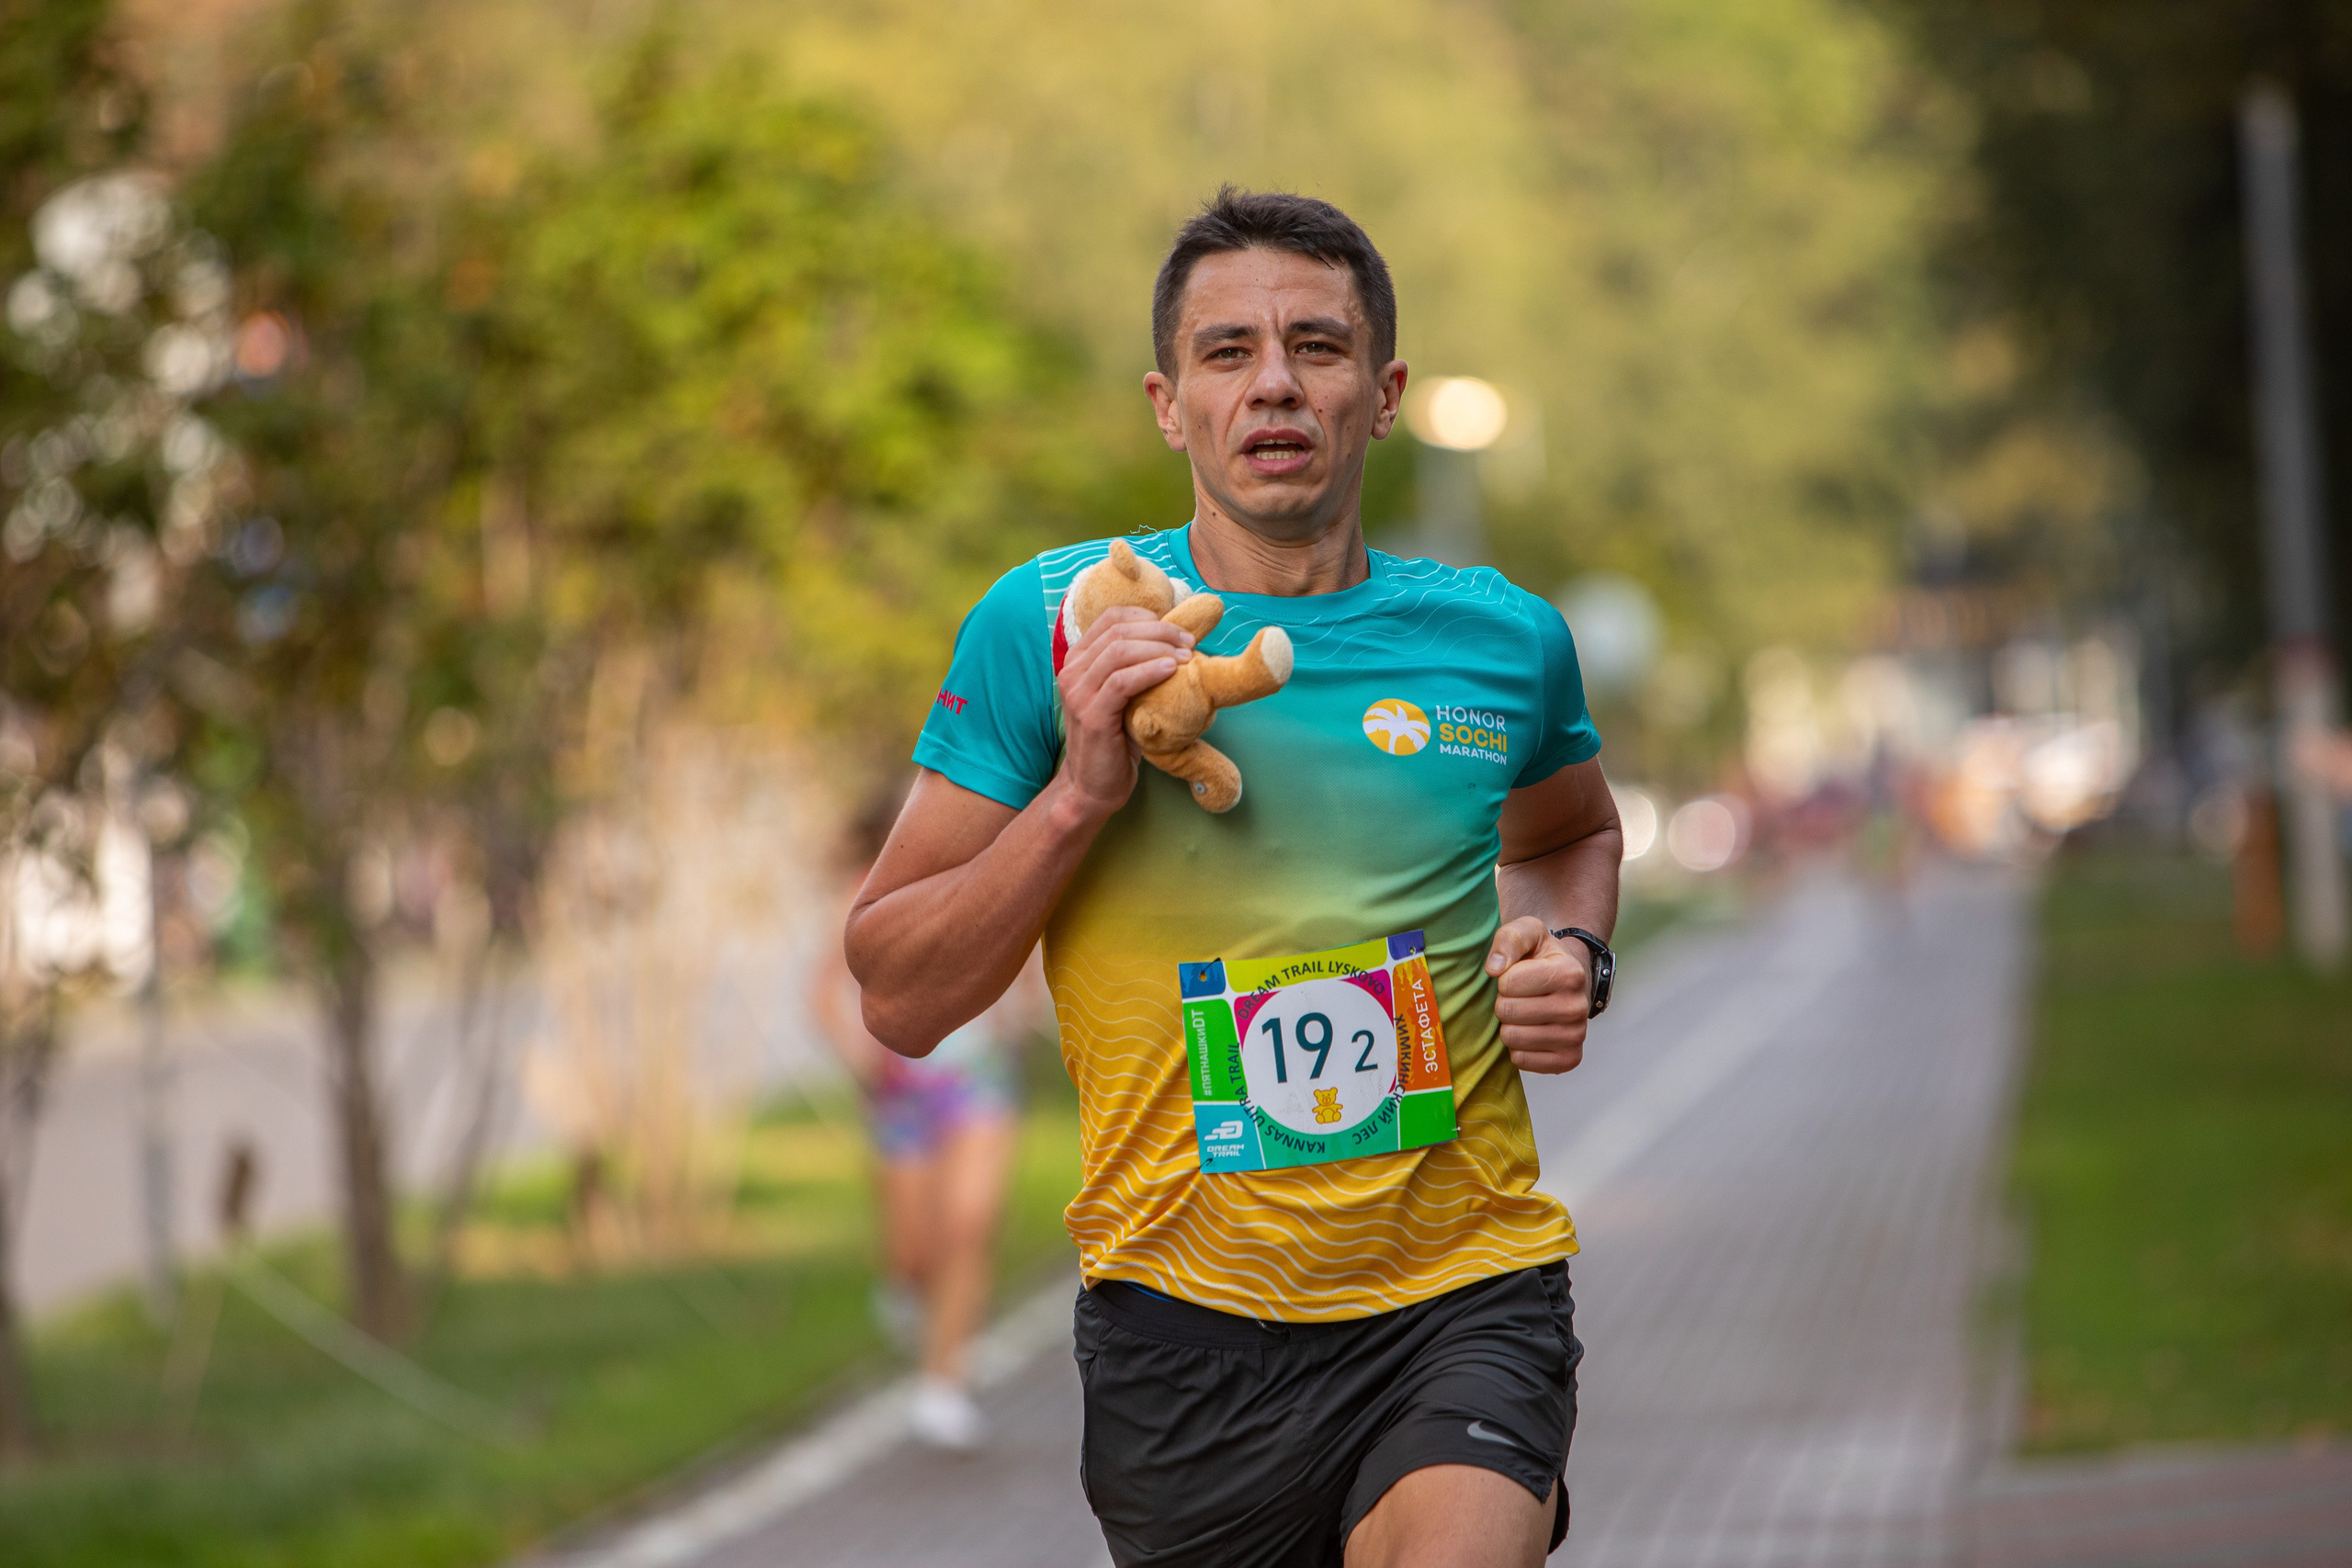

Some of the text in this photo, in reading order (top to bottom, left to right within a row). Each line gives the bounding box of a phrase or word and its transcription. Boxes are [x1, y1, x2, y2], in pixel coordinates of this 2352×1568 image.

[1436, 705, 1506, 732] HONOR
[1439, 723, 1507, 752] SOCHI
[1440, 743, 1507, 765] MARATHON
[1237, 961, 1385, 1020] DREAM TRAIL LYSKOVO
[1412, 978, 1439, 1073] ЭСТАФЕТА
[1227, 1042, 1241, 1084] TRAIL
[1261, 1012, 1378, 1084] 19 2
[1351, 1013, 1411, 1145] ХИМКИНСКИЙ ЛЕС
[1206, 1144, 1244, 1153] DREAM
[1264, 1125, 1326, 1154] KANNAS
